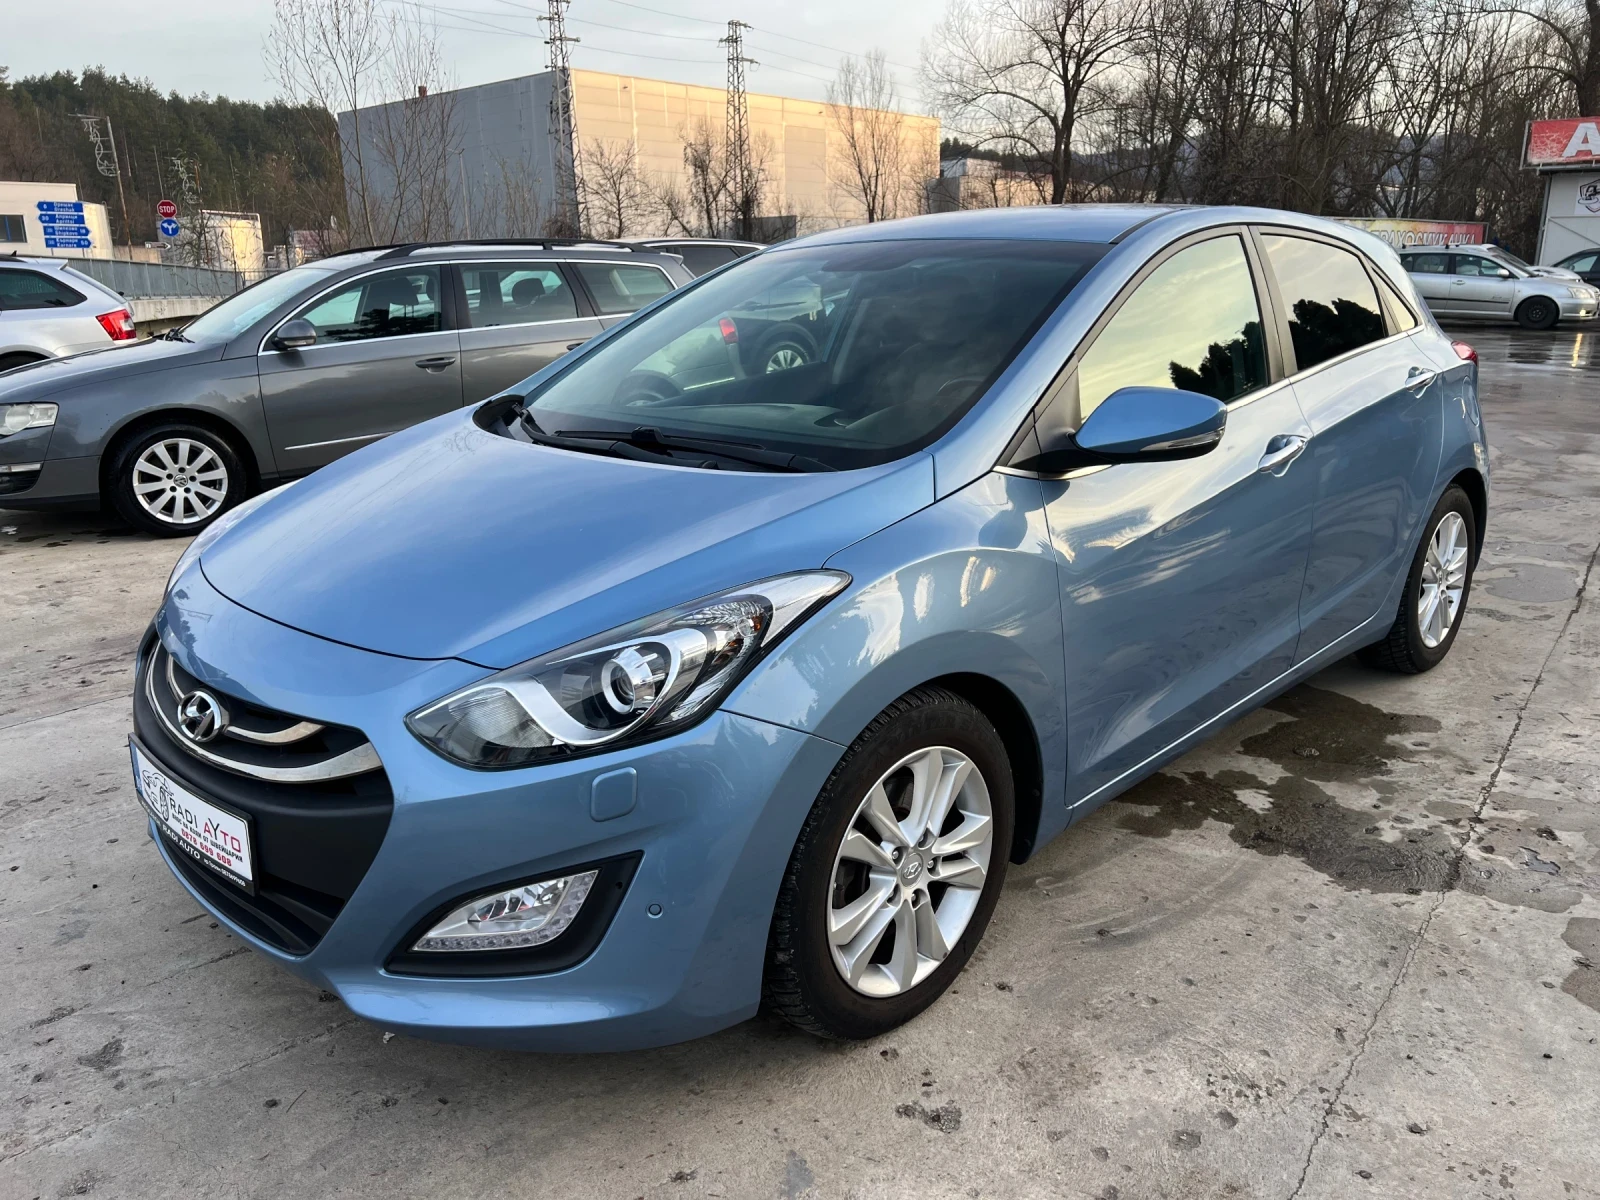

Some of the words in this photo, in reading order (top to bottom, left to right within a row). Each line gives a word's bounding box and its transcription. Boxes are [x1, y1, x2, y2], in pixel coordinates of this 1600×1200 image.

[158, 205, 175, 214] STOP
[169, 797, 198, 829] RADI
[179, 840, 201, 860] AUTO
[181, 827, 198, 846] 0878
[199, 841, 214, 857] 699
[216, 852, 232, 867] 608
